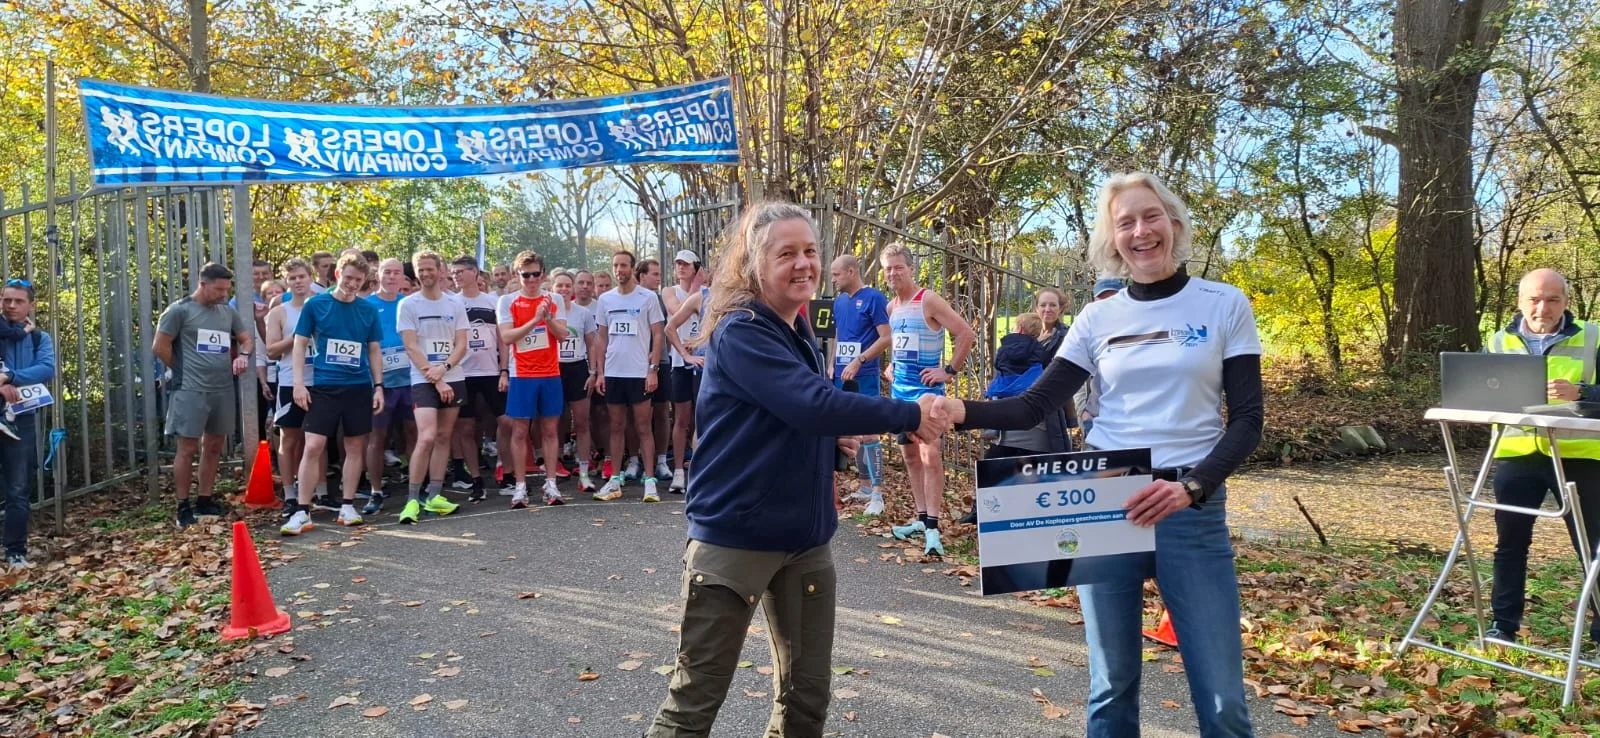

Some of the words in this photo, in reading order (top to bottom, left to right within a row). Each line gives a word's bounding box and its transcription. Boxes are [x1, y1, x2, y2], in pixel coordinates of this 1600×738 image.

[615, 322, 630, 333] 131
[208, 333, 221, 345] 61
[472, 328, 480, 340] 3
[525, 335, 538, 346] 97
[895, 336, 910, 349] 27
[334, 342, 356, 356] 162
[432, 341, 451, 353] 175
[839, 344, 856, 356] 109
[386, 354, 400, 366] 96
[1021, 457, 1109, 476] CHEQUE
[1035, 491, 1051, 508] €
[1057, 488, 1096, 507] 300
